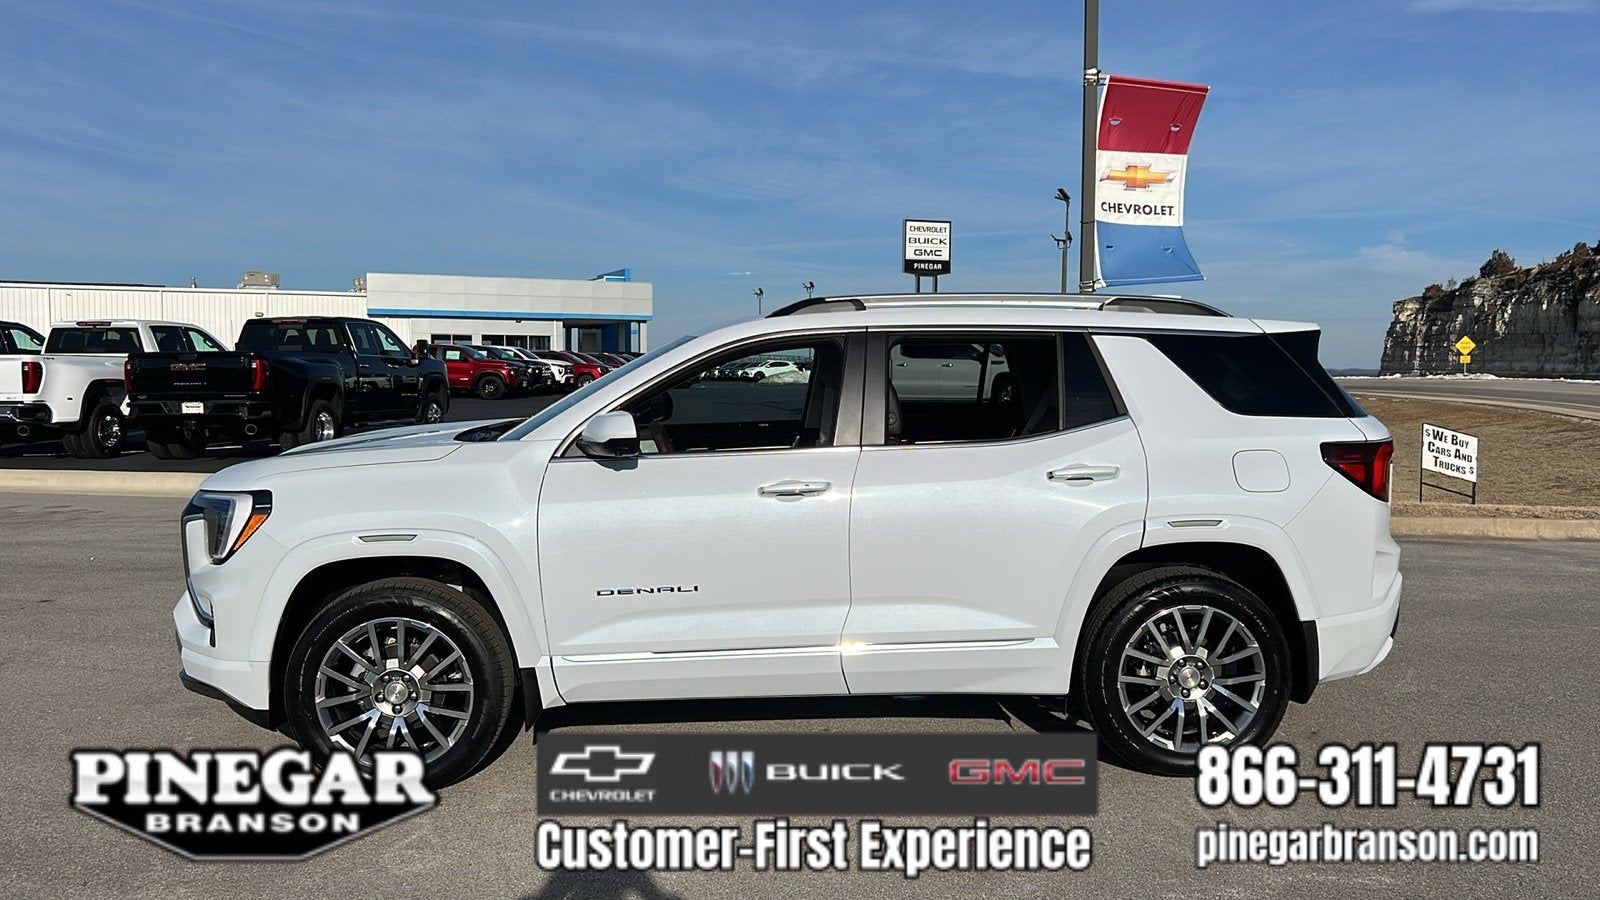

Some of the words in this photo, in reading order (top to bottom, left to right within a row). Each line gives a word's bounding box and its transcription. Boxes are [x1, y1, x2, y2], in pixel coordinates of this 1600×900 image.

[1101, 201, 1175, 216] CHEVROLET
[909, 225, 947, 233] CHEVROLET
[908, 237, 947, 245] BUICK
[913, 249, 942, 257] GMC
[913, 262, 942, 270] PINEGAR
[1432, 429, 1448, 444] WE
[1451, 434, 1469, 448] BUY
[1428, 441, 1451, 457] CARS
[1454, 449, 1472, 462] AND
[1433, 455, 1466, 474] TRUCKS
[596, 585, 698, 596] DENALI
